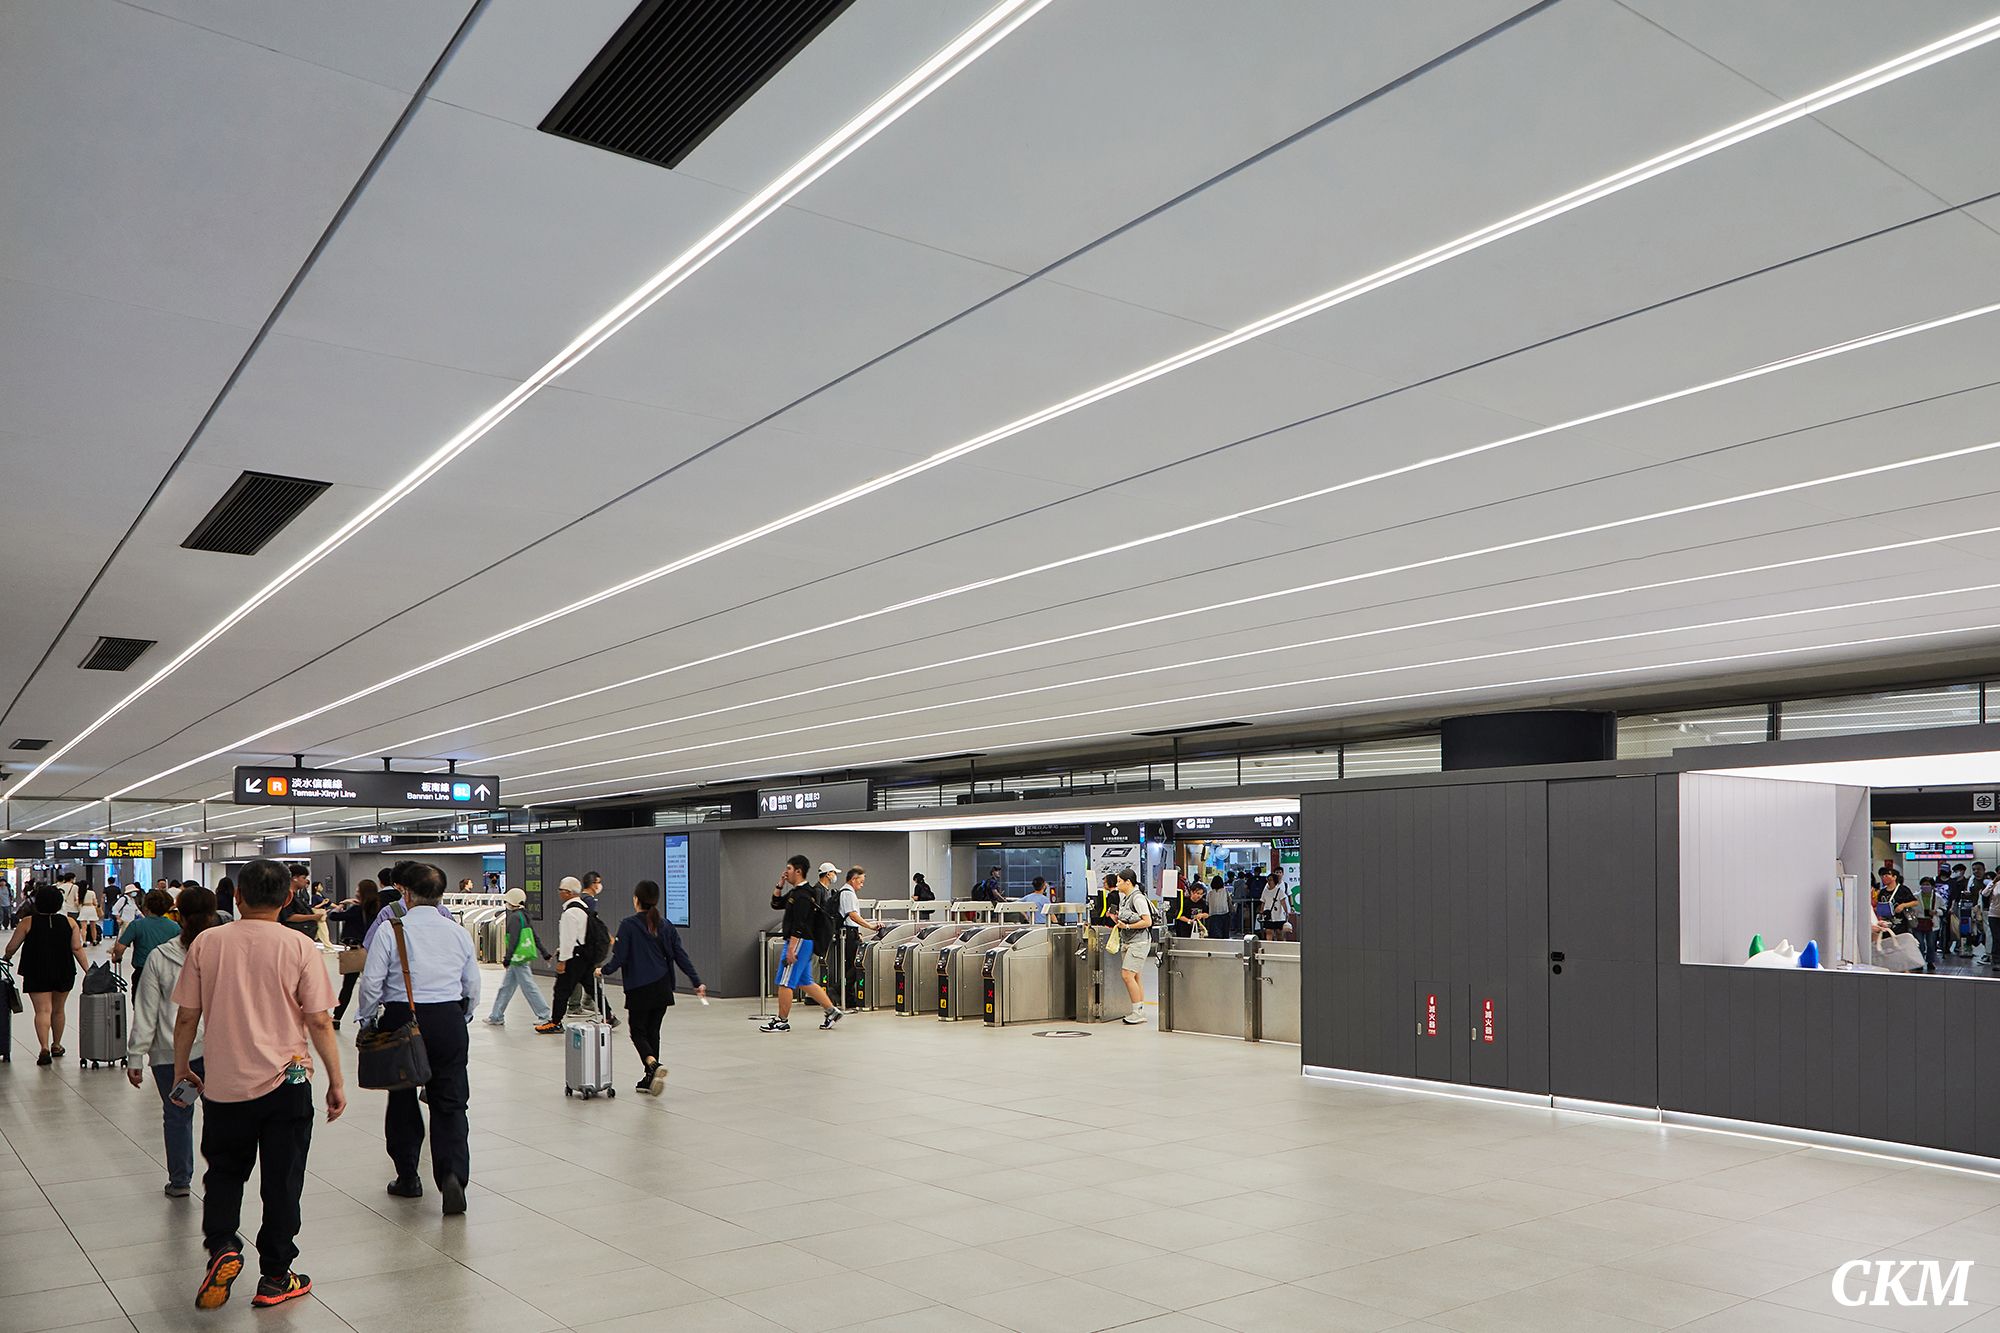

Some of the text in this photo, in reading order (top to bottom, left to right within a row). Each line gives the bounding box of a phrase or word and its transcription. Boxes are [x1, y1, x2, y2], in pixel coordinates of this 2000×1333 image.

[272, 781, 282, 791] R
[421, 782, 450, 792] 板南線
[292, 789, 357, 799] Tamsui-Xinyi Line
